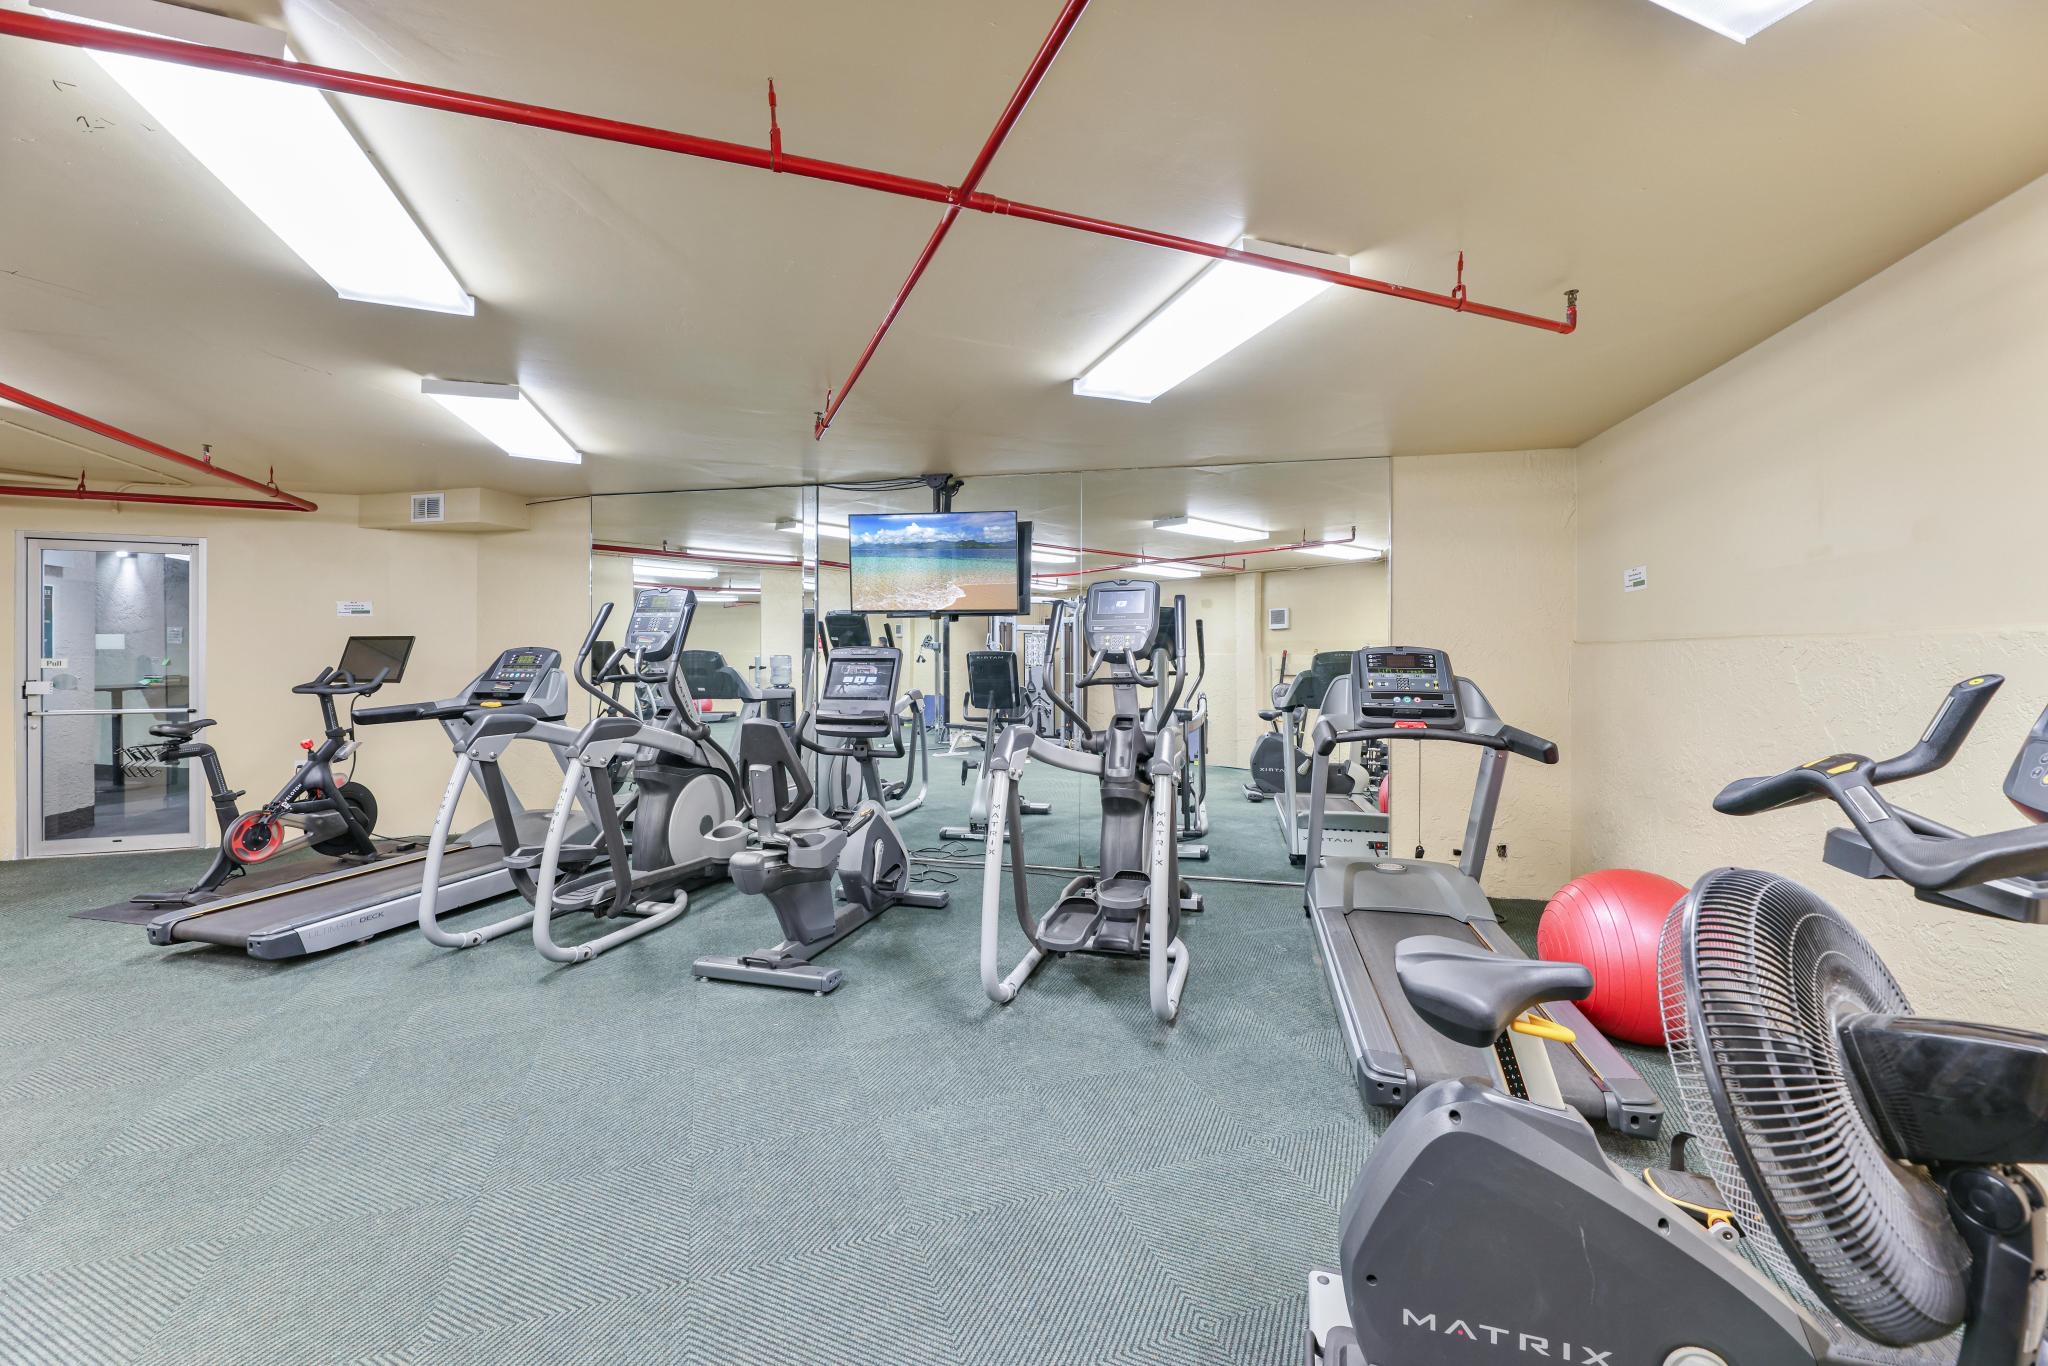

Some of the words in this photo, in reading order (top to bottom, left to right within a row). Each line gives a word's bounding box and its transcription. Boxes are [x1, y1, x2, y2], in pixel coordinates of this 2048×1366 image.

[988, 804, 1001, 855] MATRIX
[1156, 811, 1166, 866] MATRIX
[360, 912, 385, 923] DECK
[1402, 1308, 1613, 1366] MATRIX
